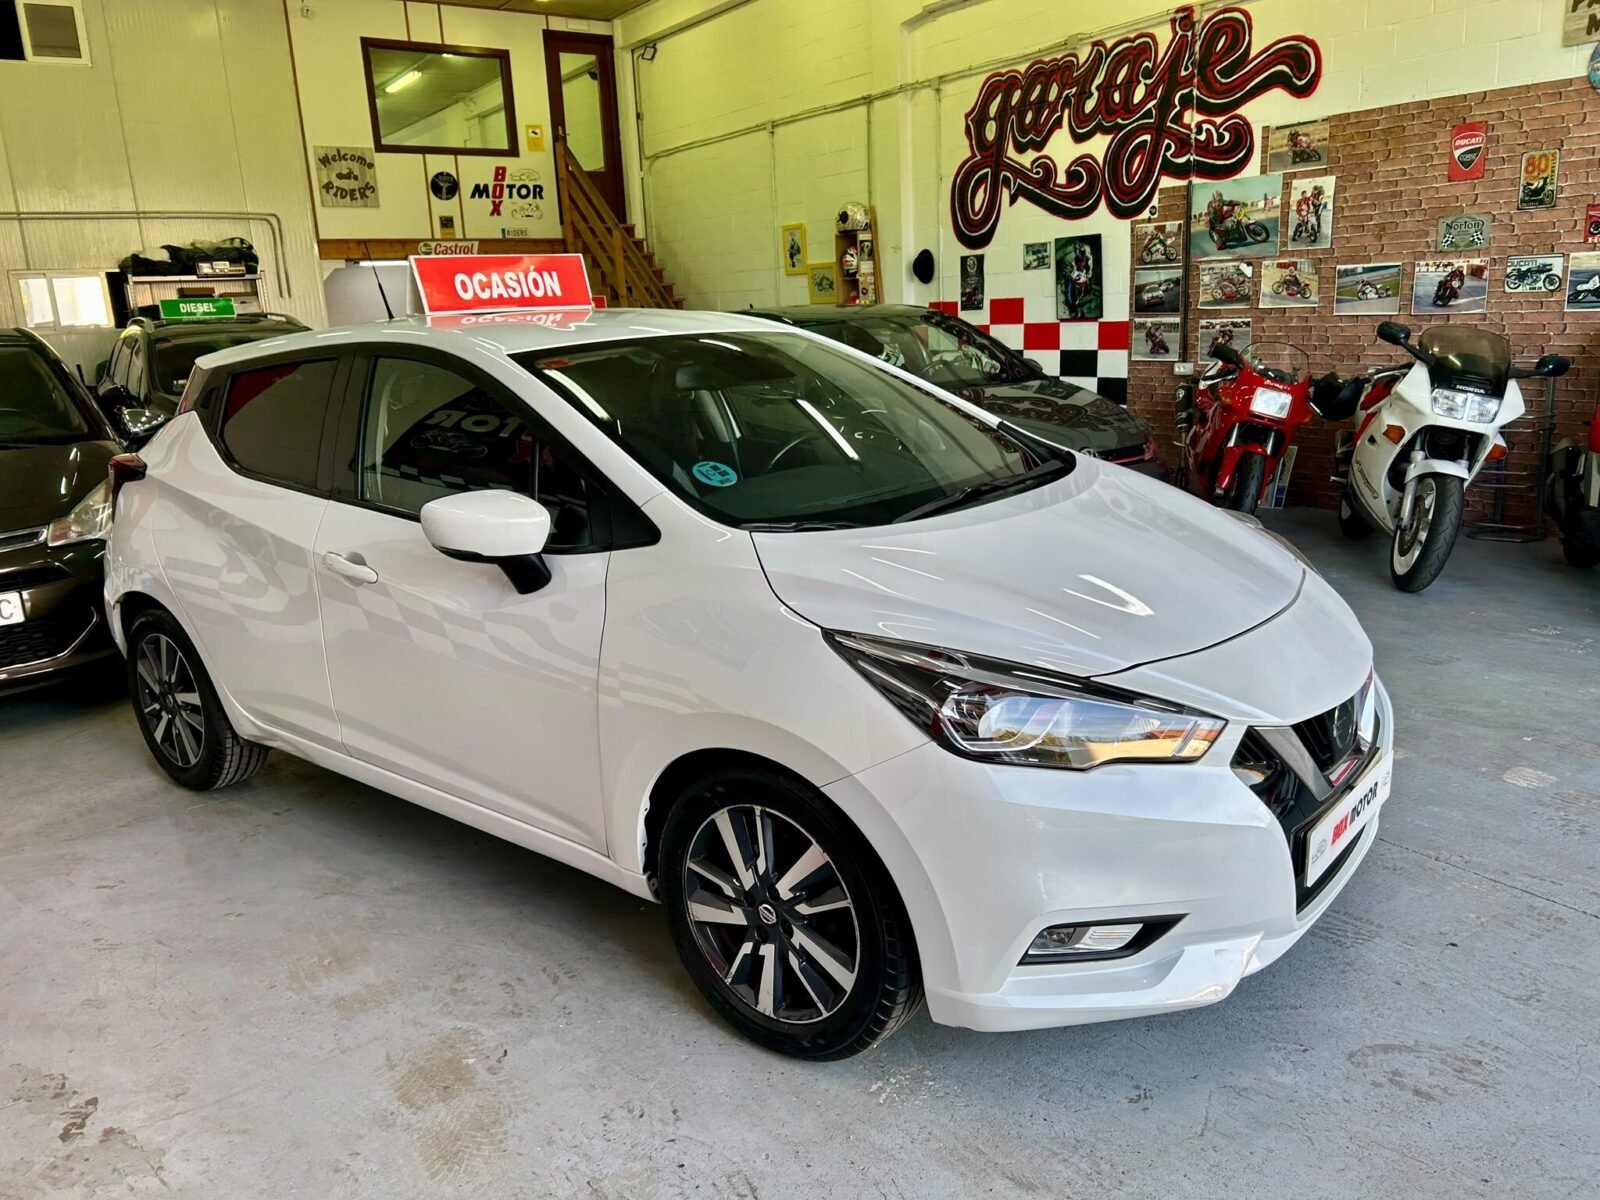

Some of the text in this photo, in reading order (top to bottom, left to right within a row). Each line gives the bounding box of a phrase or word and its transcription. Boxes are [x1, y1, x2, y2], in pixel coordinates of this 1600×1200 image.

[951, 6, 1322, 250] garaje
[1455, 136, 1483, 146] DUCATI
[318, 147, 374, 169] Welcome
[322, 181, 376, 201] RIDERS
[470, 183, 544, 200] MOTOR
[1443, 219, 1485, 232] Norton
[434, 243, 475, 255] Castrol
[454, 265, 562, 300] OCASIÓN
[179, 303, 217, 313] DIESEL
[1456, 384, 1486, 394] HONDA
[1349, 781, 1379, 826] MOTOR
